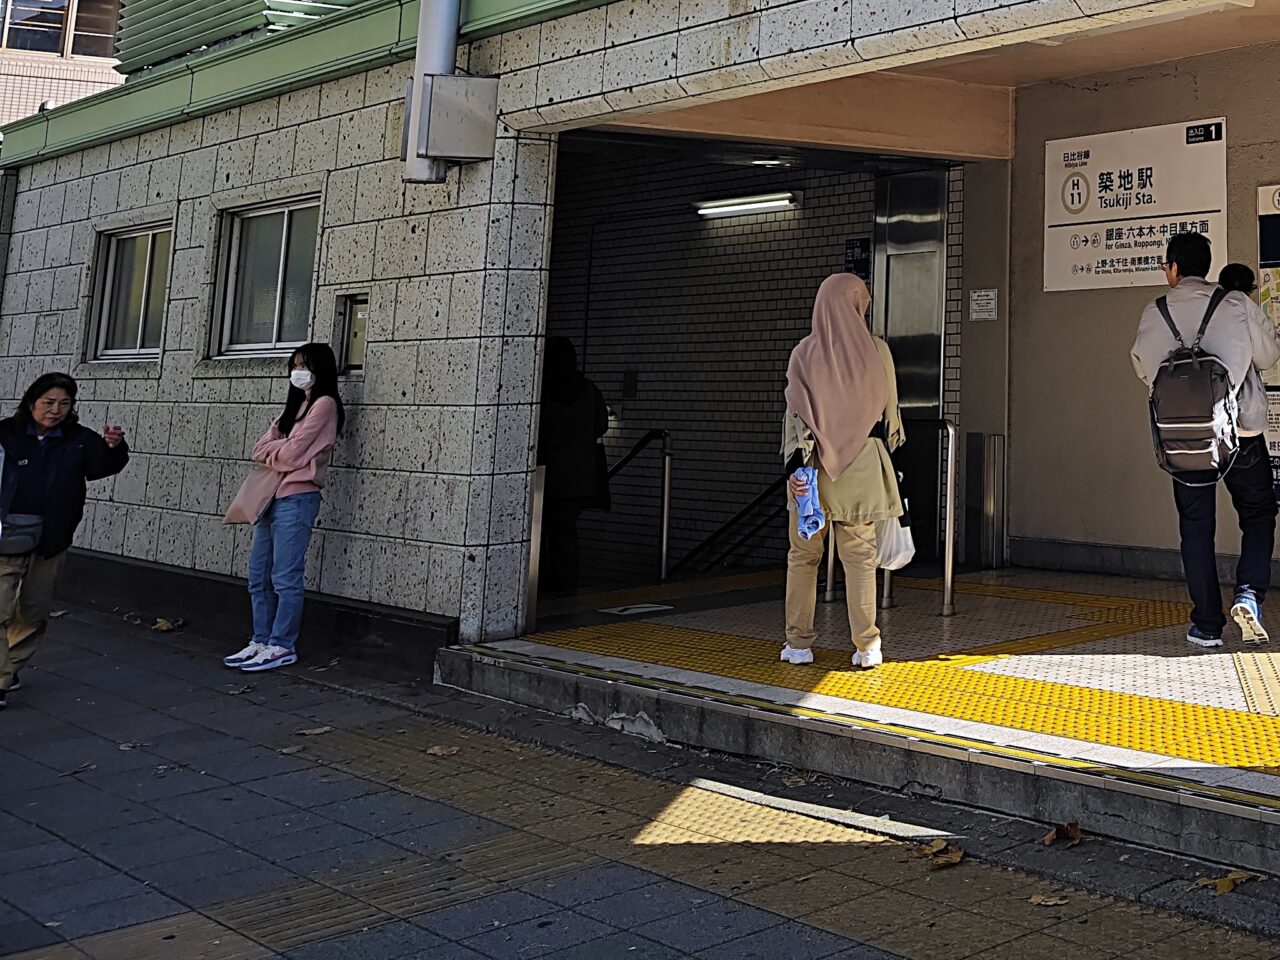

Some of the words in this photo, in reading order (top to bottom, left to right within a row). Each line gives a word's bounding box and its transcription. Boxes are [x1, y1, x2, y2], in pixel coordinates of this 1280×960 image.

[1188, 128, 1204, 137] 出入口
[1209, 125, 1216, 140] 1
[1063, 150, 1090, 162] 日比谷線
[1072, 179, 1080, 191] H
[1098, 167, 1153, 194] 築地駅
[1070, 193, 1082, 205] 11
[1098, 193, 1132, 210] Tsukiji
[1135, 192, 1157, 205] Sta.
[1105, 242, 1113, 250] for
[1115, 241, 1133, 250] Ginza,
[1134, 239, 1164, 250] Roppongi,
